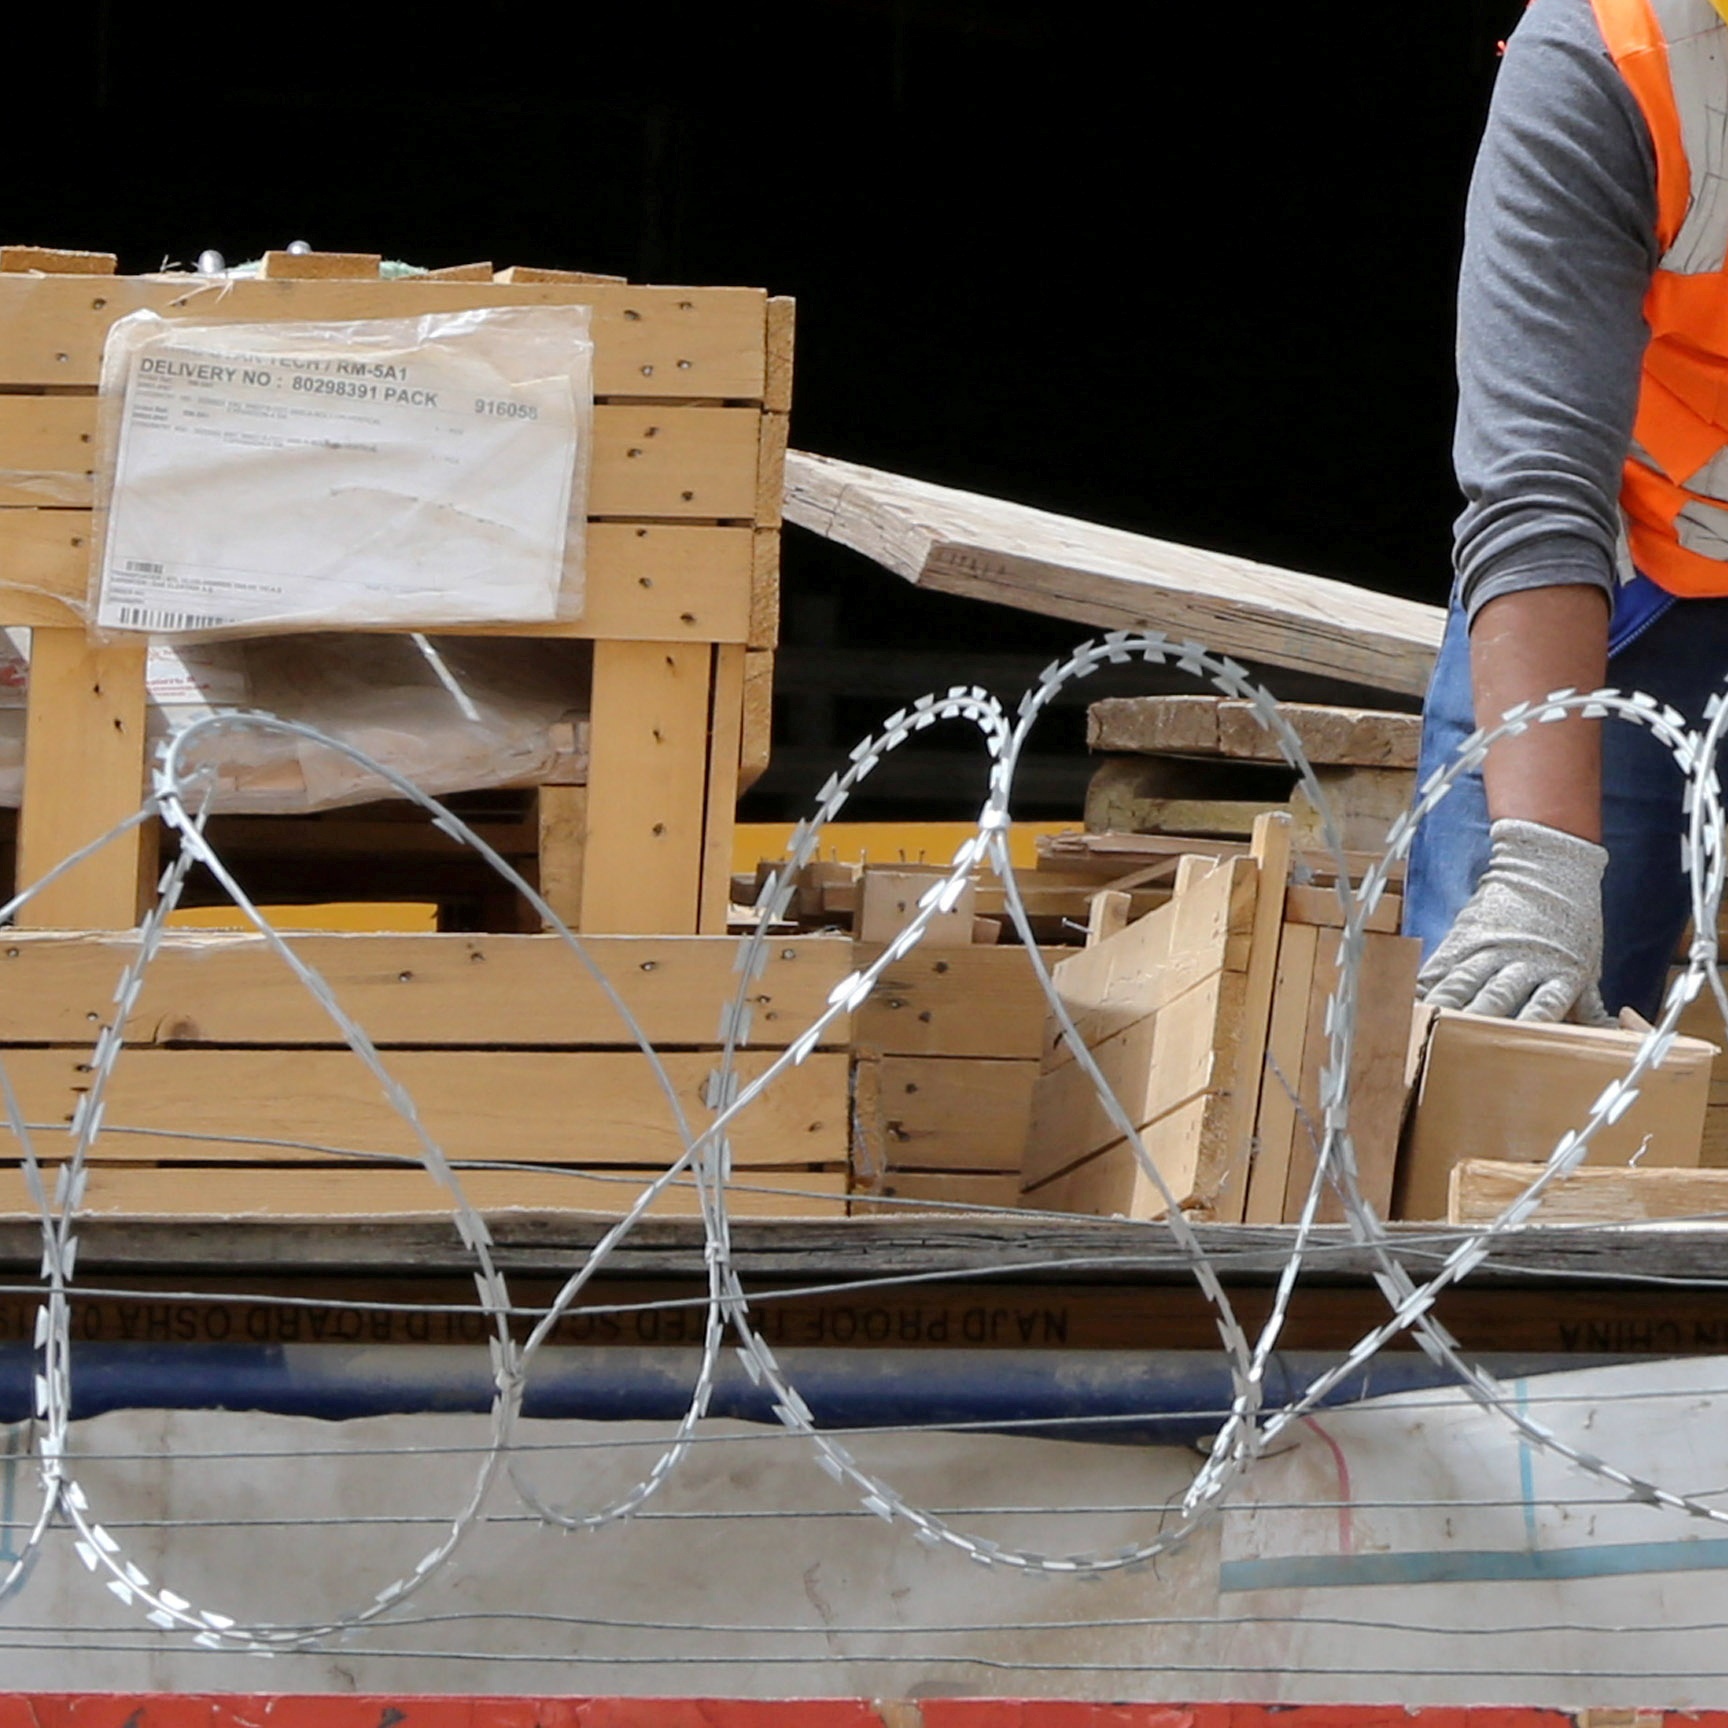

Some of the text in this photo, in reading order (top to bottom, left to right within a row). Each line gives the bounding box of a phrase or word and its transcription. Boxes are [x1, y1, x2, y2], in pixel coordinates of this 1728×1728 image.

[141, 358, 236, 382] DELIVERY
[243, 369, 272, 386] NO
[292, 376, 377, 399] 80298391
[384, 387, 439, 408] PACK
